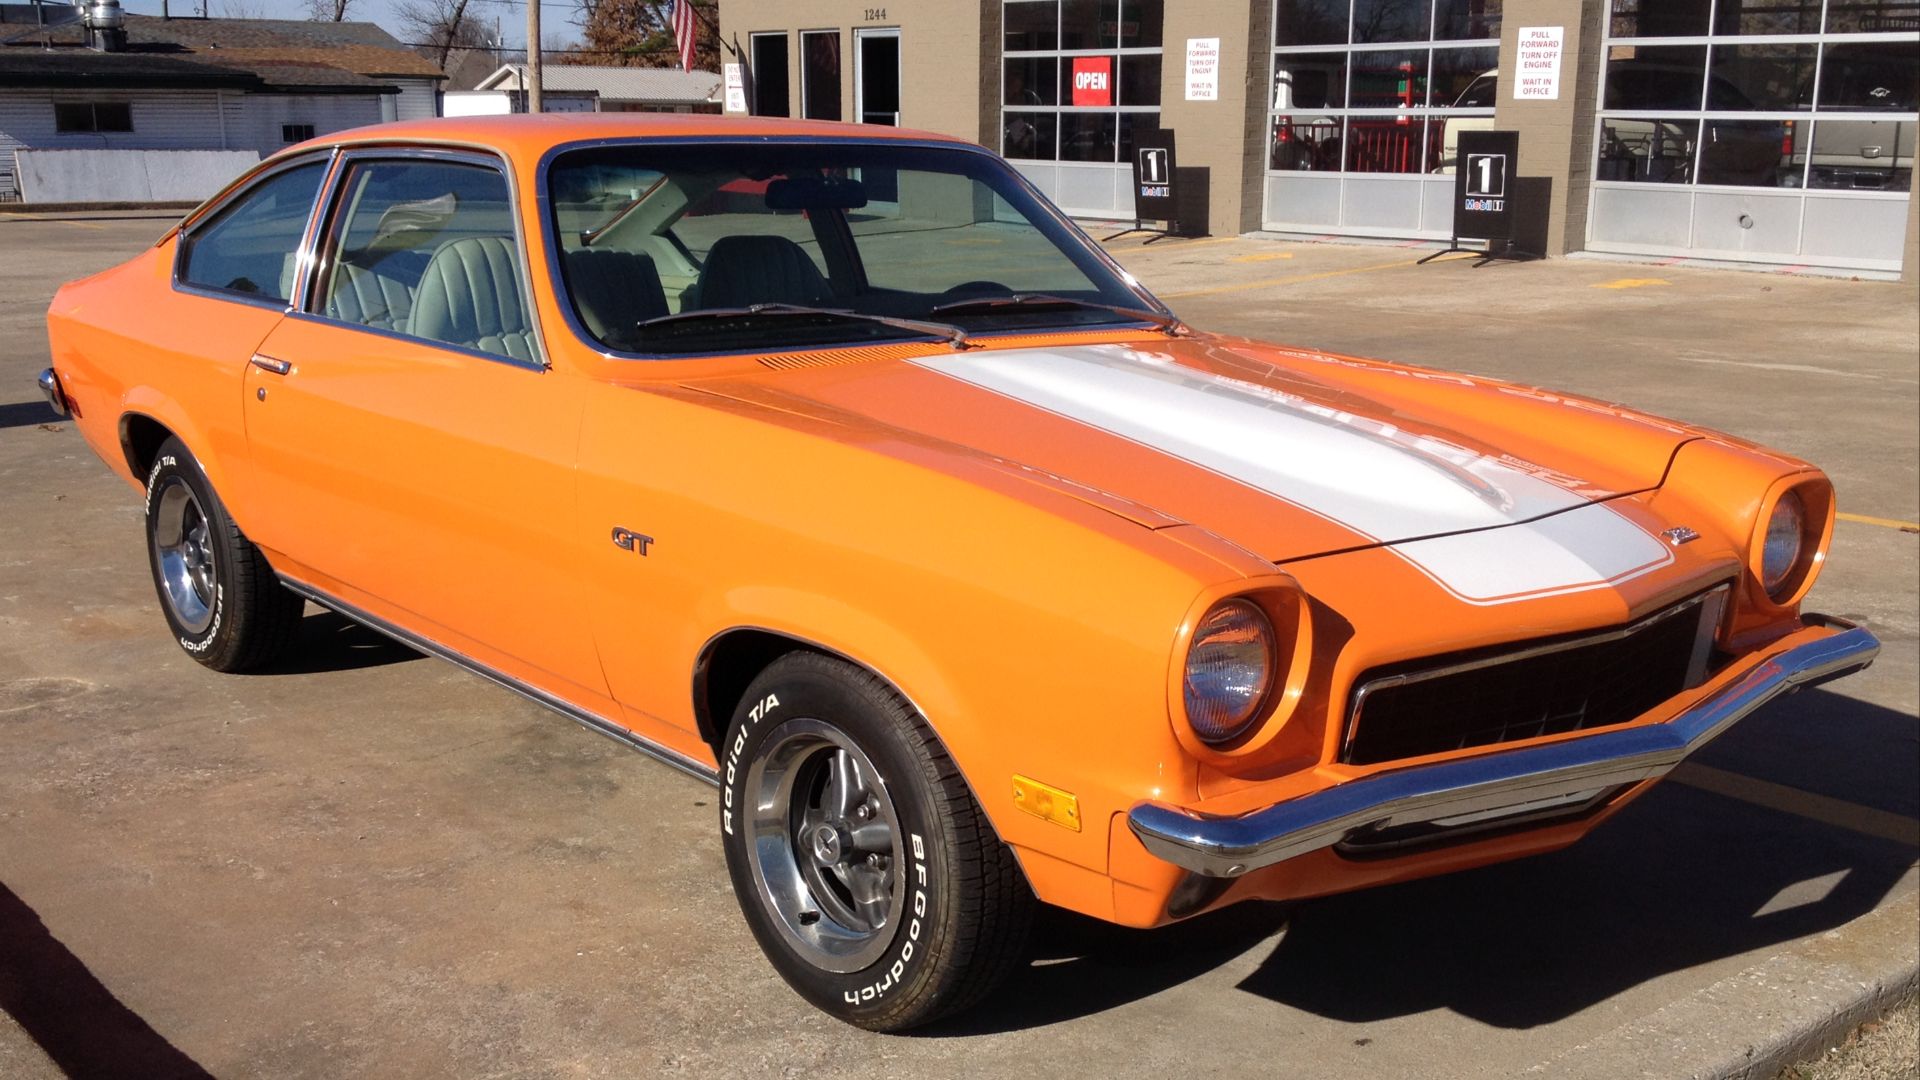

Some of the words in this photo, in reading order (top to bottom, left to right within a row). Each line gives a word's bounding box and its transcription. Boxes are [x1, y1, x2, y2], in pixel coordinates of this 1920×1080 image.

[864, 8, 887, 21] 1244
[1521, 40, 1559, 48] FORWARD
[1521, 51, 1541, 59] TURN
[1543, 51, 1558, 59] OFF
[1524, 61, 1552, 69] ENGINE
[1075, 72, 1107, 90] OPEN
[1522, 78, 1541, 86] WAIT
[1544, 78, 1552, 86] IN
[1523, 87, 1550, 95] OFFICE
[1147, 151, 1158, 182] 1
[1478, 157, 1491, 193] 1
[1465, 199, 1493, 211] Mobil
[162, 455, 177, 466] T/A
[611, 526, 654, 557] GT
[180, 583, 223, 653] BFGoodrich
[721, 724, 748, 836] Radial
[748, 693, 780, 724] T/A
[843, 833, 927, 1006] BFGoodrich
